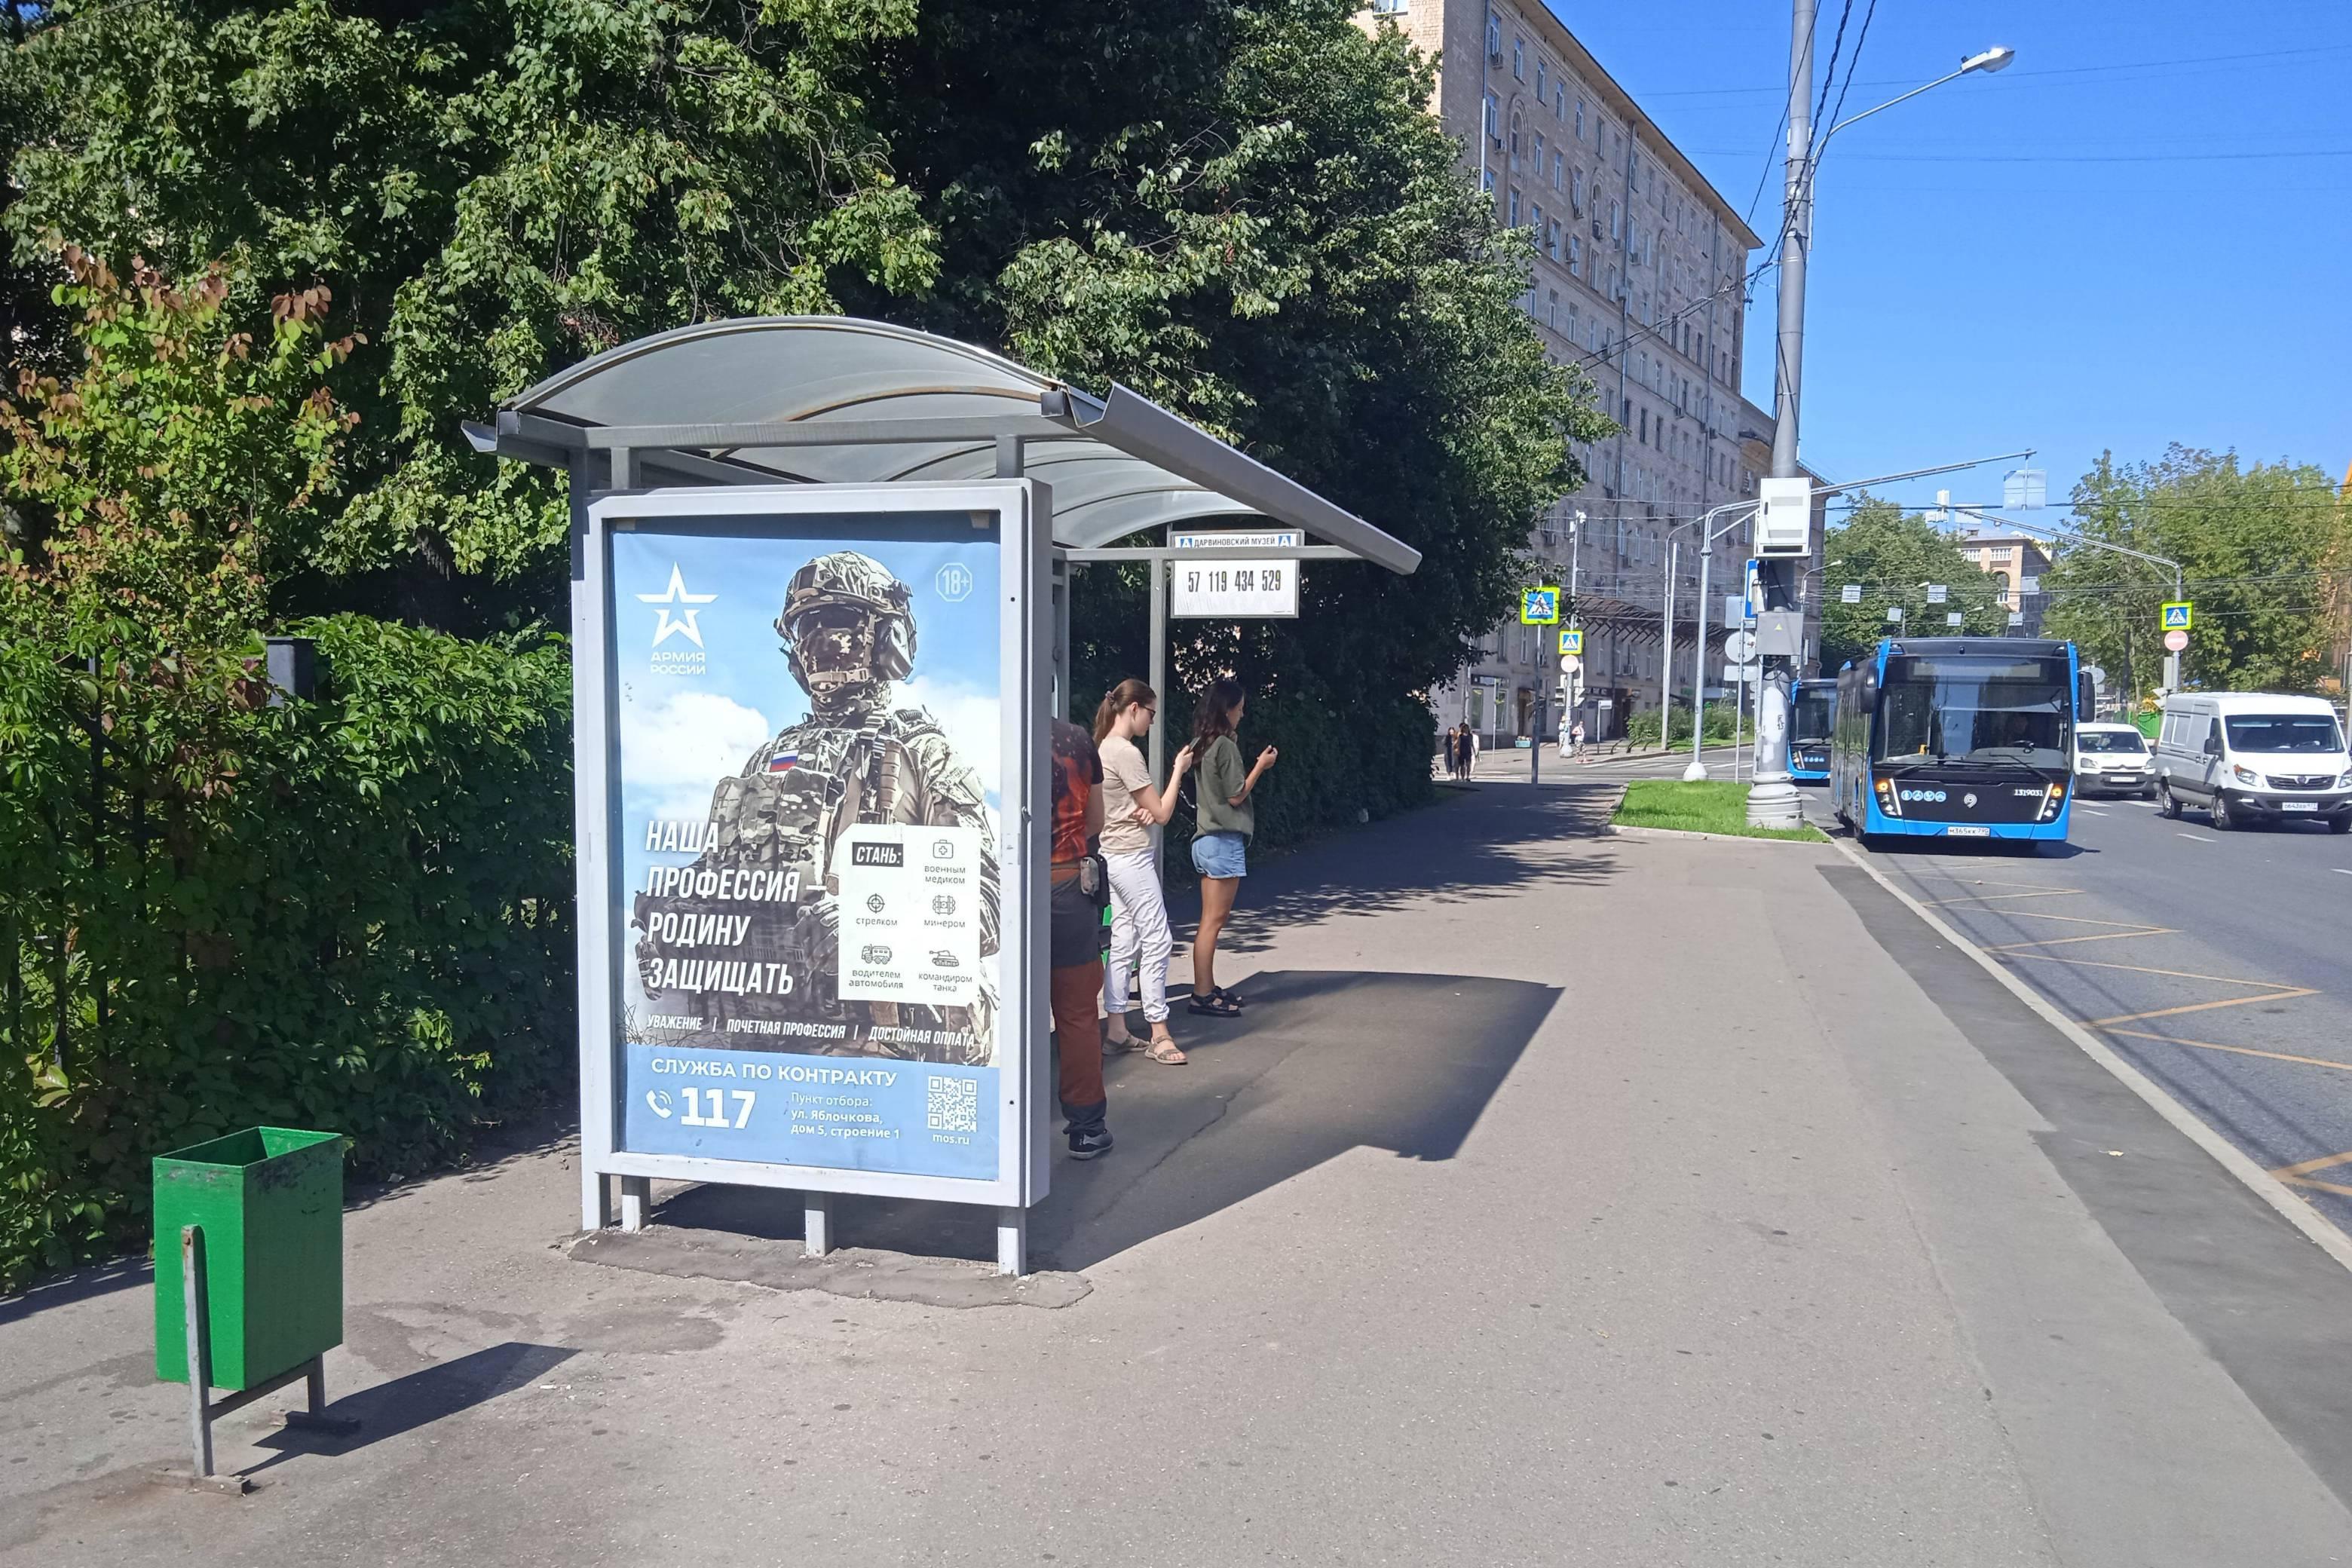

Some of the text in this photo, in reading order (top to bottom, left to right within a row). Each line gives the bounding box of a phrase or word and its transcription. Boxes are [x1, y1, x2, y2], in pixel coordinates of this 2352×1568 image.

[1194, 537, 1250, 547] ДАРВИНОВСКИЙ
[1251, 536, 1276, 546] МУЗЕЙ
[942, 570, 969, 595] 18+
[1188, 569, 1281, 593] 57 119 434 529
[651, 652, 706, 663] АРМИЯ
[650, 664, 706, 675] РОССИИ
[2014, 789, 2044, 797] 1319031
[645, 820, 719, 853] НАША
[856, 846, 902, 865] СТАНЬ:
[923, 865, 966, 874] военным
[646, 866, 801, 903] ПРОФЕССИЯ
[925, 875, 966, 885] медиком
[856, 917, 898, 927] стрелком
[923, 919, 966, 929] минером
[647, 911, 752, 948] РОДИНУ
[648, 957, 794, 997] ЗАЩИЩАТЬ
[852, 969, 901, 979] водителем
[918, 973, 972, 984] командиром
[849, 979, 904, 989] автомобиля
[933, 983, 957, 993] танка
[647, 1014, 975, 1046] УВАЖЕНИЕ ПОЧЕТНАЯ ПРОФЕССИЯ ДОСТОЙНАЯ ОПЛАТА
[651, 1058, 898, 1086] СЛУЖБА ПО КОНТРАКТУ
[791, 1092, 873, 1107] Пункт отбора:
[681, 1087, 757, 1129] 117
[791, 1110, 884, 1124] ул. Яблочкова,
[790, 1124, 900, 1139] дом 5, строение 1
[933, 1134, 970, 1145] mos.ru
